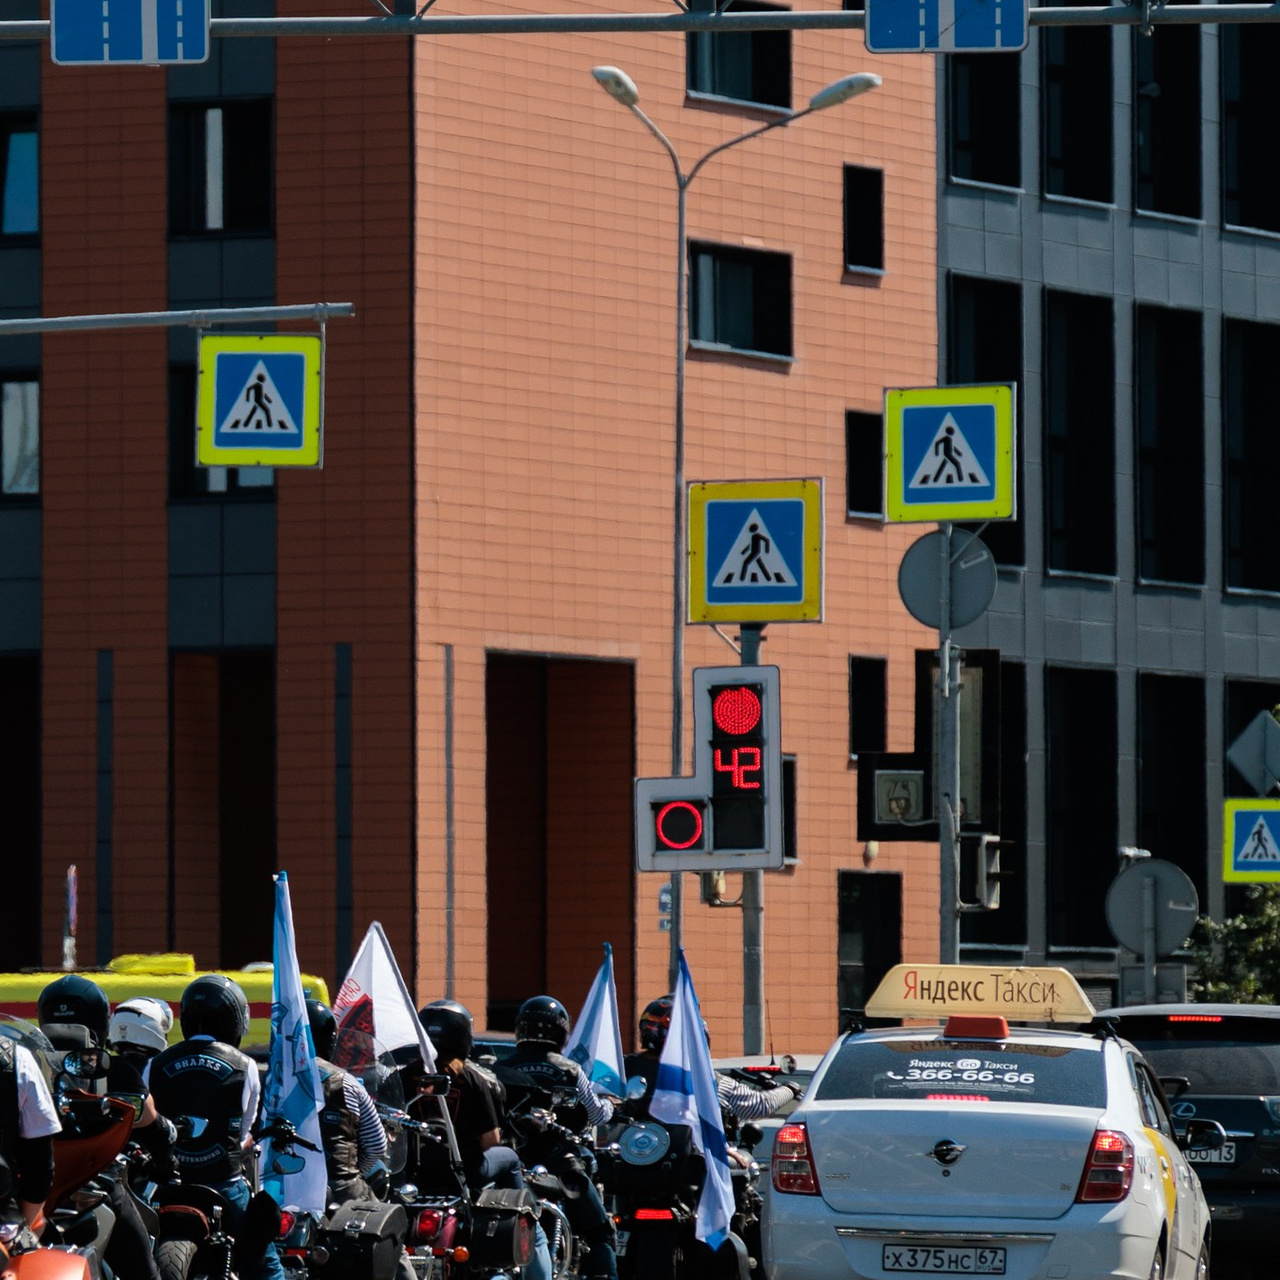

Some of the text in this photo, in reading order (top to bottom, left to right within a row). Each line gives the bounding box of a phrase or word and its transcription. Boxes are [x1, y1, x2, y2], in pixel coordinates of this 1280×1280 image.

[714, 747, 761, 788] 42
[903, 970, 1055, 1004] Яндекс Такси
[174, 1058, 222, 1071] SHARKS
[909, 1059, 955, 1070] Яндекс
[983, 1061, 1018, 1070] Такси
[905, 1069, 1036, 1084] 366-66-66
[978, 1250, 998, 1265] 67
